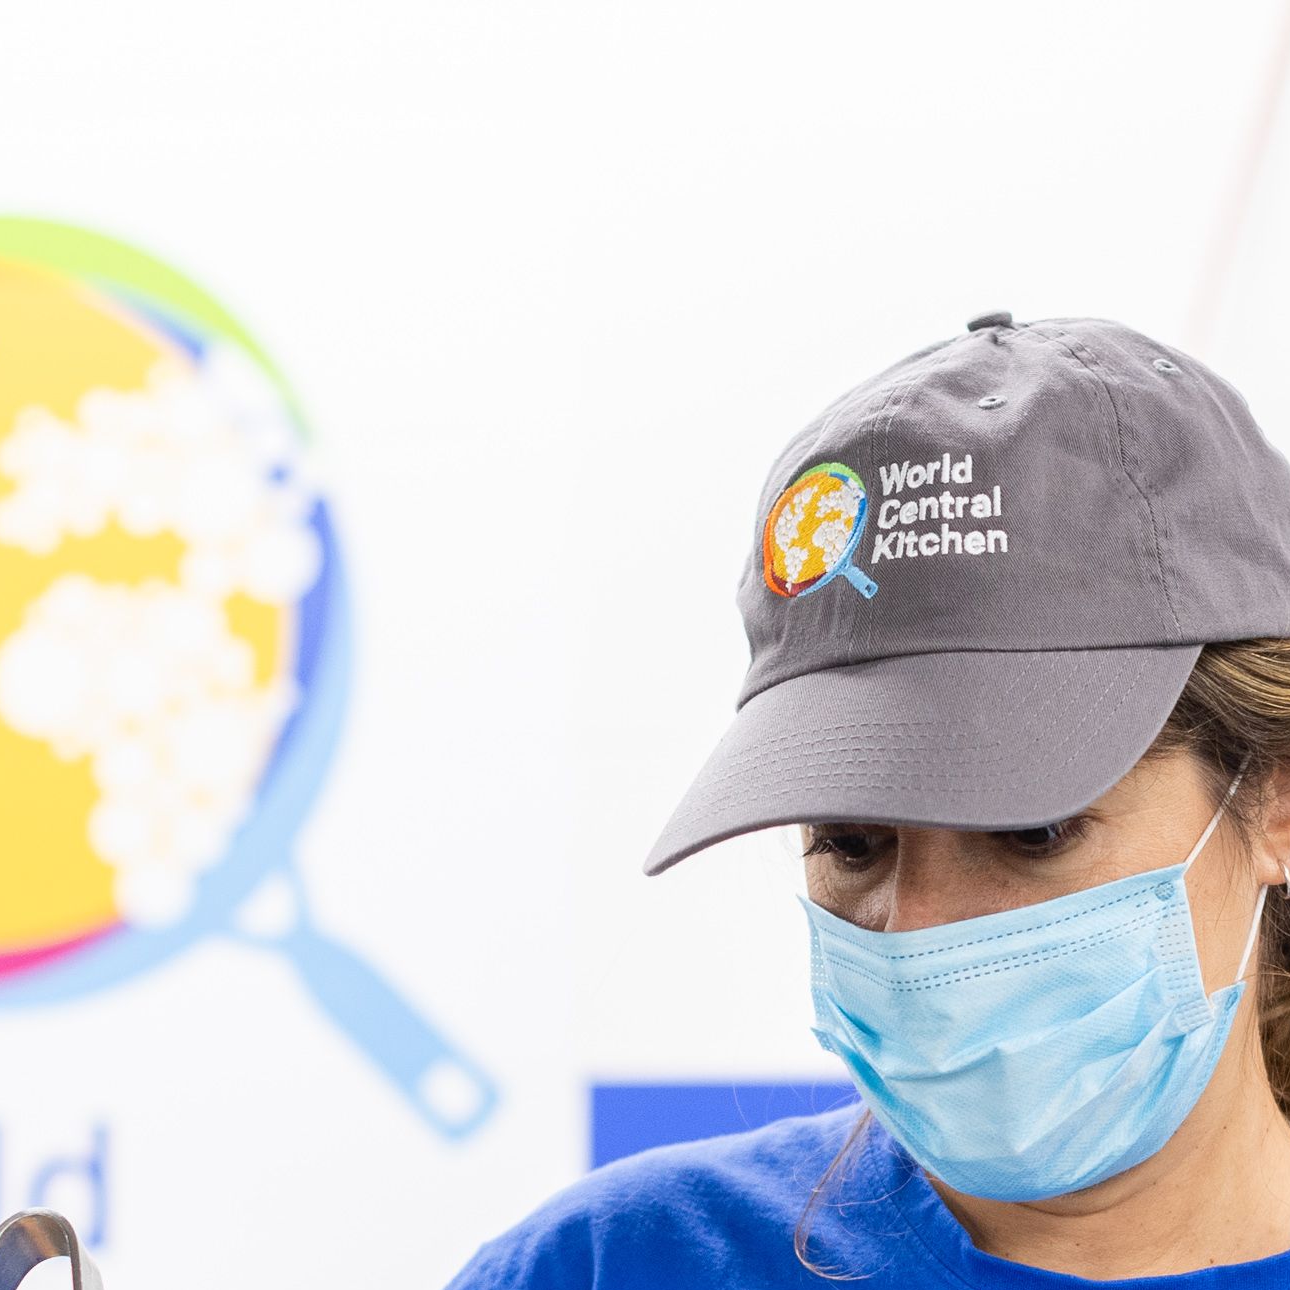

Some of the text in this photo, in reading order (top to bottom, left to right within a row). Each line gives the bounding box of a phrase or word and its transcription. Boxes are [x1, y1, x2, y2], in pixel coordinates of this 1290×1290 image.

[879, 453, 973, 496] World
[876, 485, 1003, 530] Central
[871, 523, 1008, 563] Kitchen
